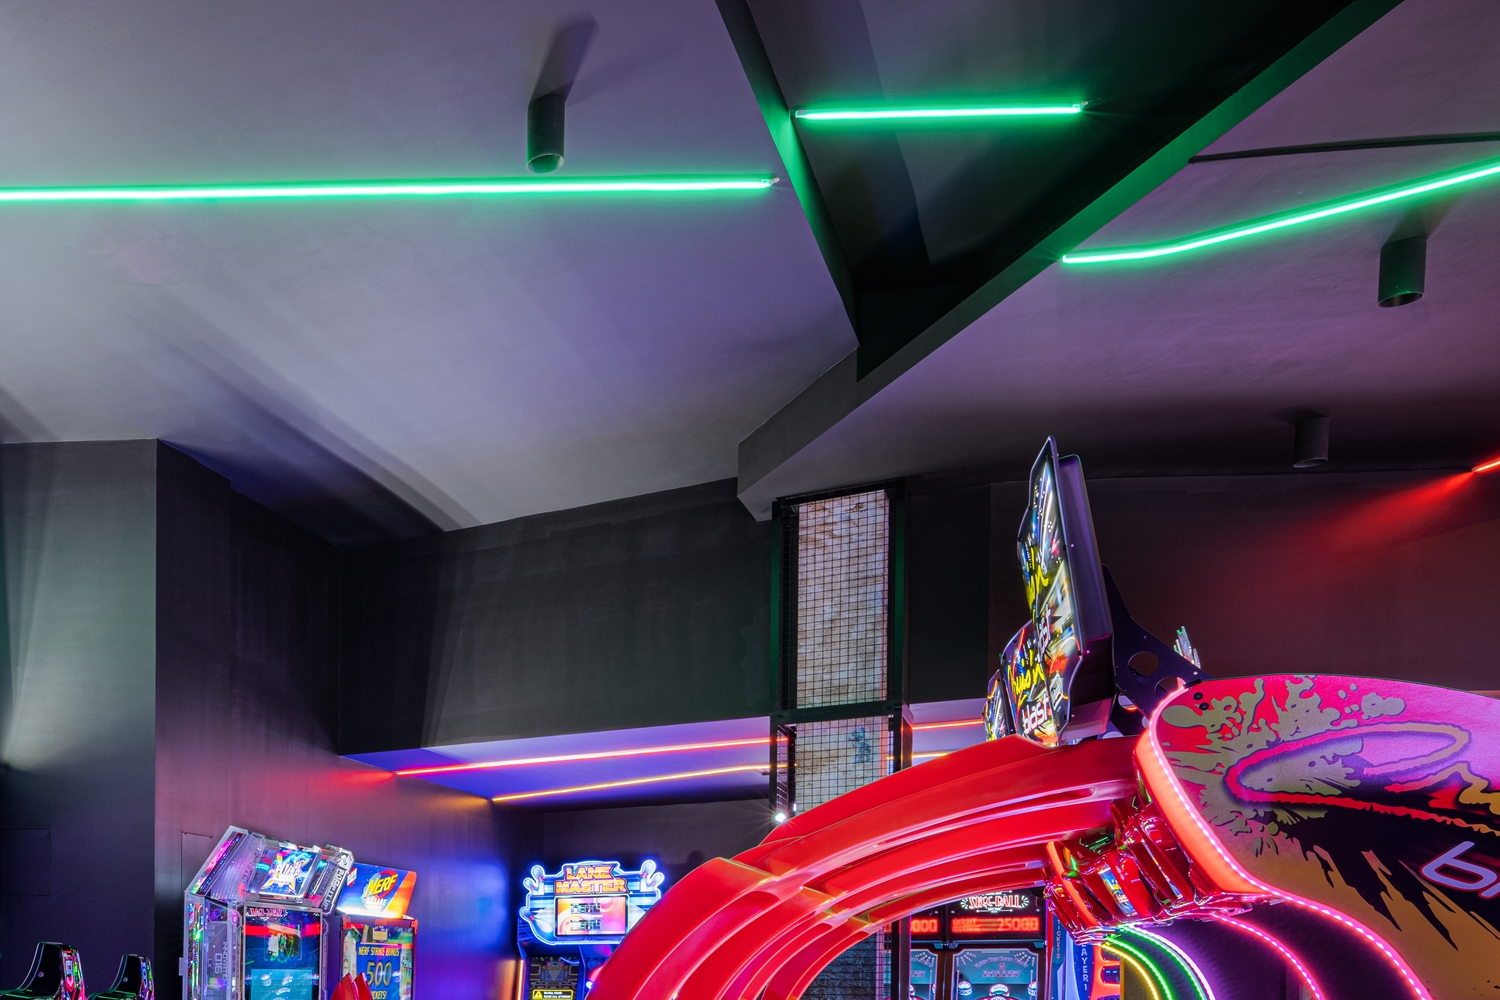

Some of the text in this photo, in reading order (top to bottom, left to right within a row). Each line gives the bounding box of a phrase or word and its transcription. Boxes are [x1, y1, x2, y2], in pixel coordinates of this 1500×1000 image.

[1022, 694, 1051, 735] blast
[363, 870, 399, 898] NERF
[555, 878, 628, 894] MASTER
[566, 866, 613, 880] LANE
[358, 946, 370, 956] NERF
[1080, 944, 1089, 982] AYER
[366, 961, 392, 987] 500
